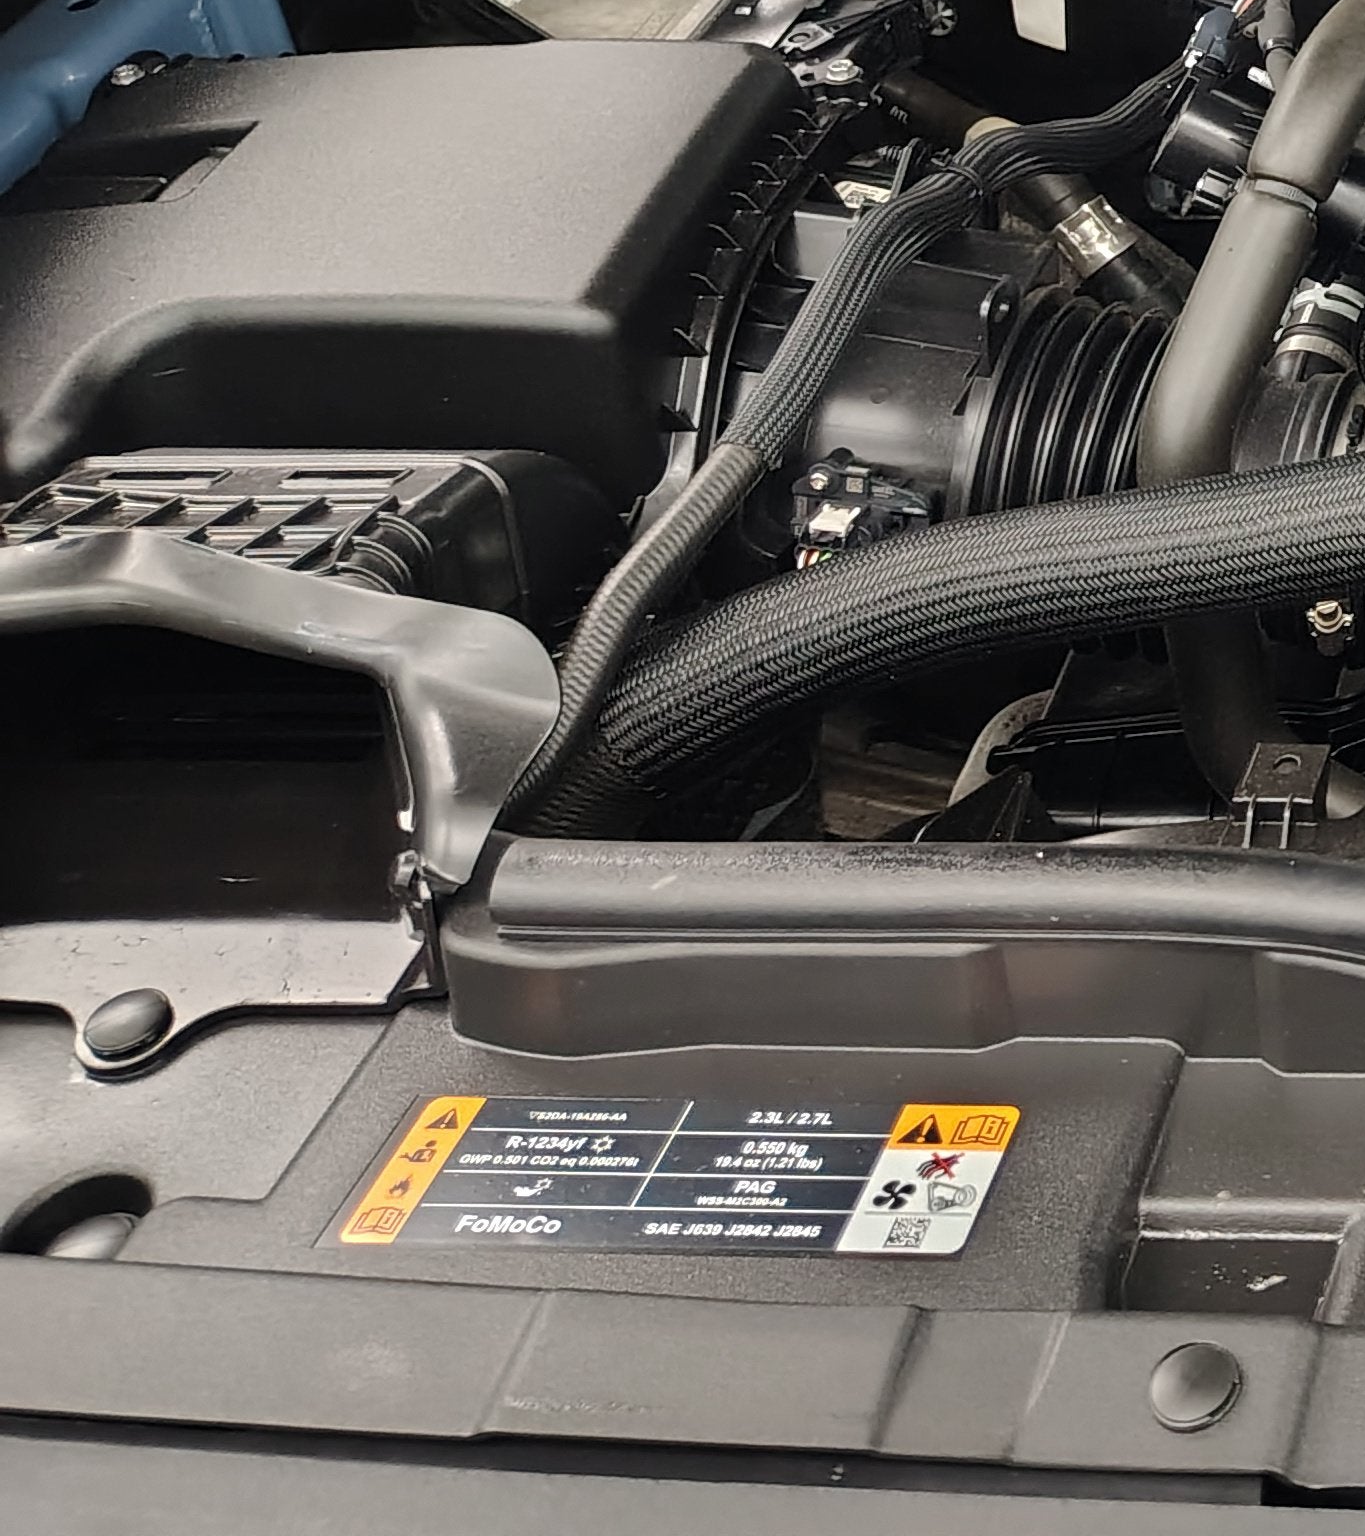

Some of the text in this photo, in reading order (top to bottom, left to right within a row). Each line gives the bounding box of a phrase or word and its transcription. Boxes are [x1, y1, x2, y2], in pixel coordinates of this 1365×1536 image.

[748, 1112, 784, 1124] 2.3L
[796, 1113, 832, 1125] 2.7L
[505, 1135, 587, 1152] R-1234yf
[742, 1141, 809, 1157] 0.550 kg
[734, 1180, 777, 1193] PAG
[454, 1214, 562, 1233] FoMoCo
[644, 1222, 682, 1235] SAE
